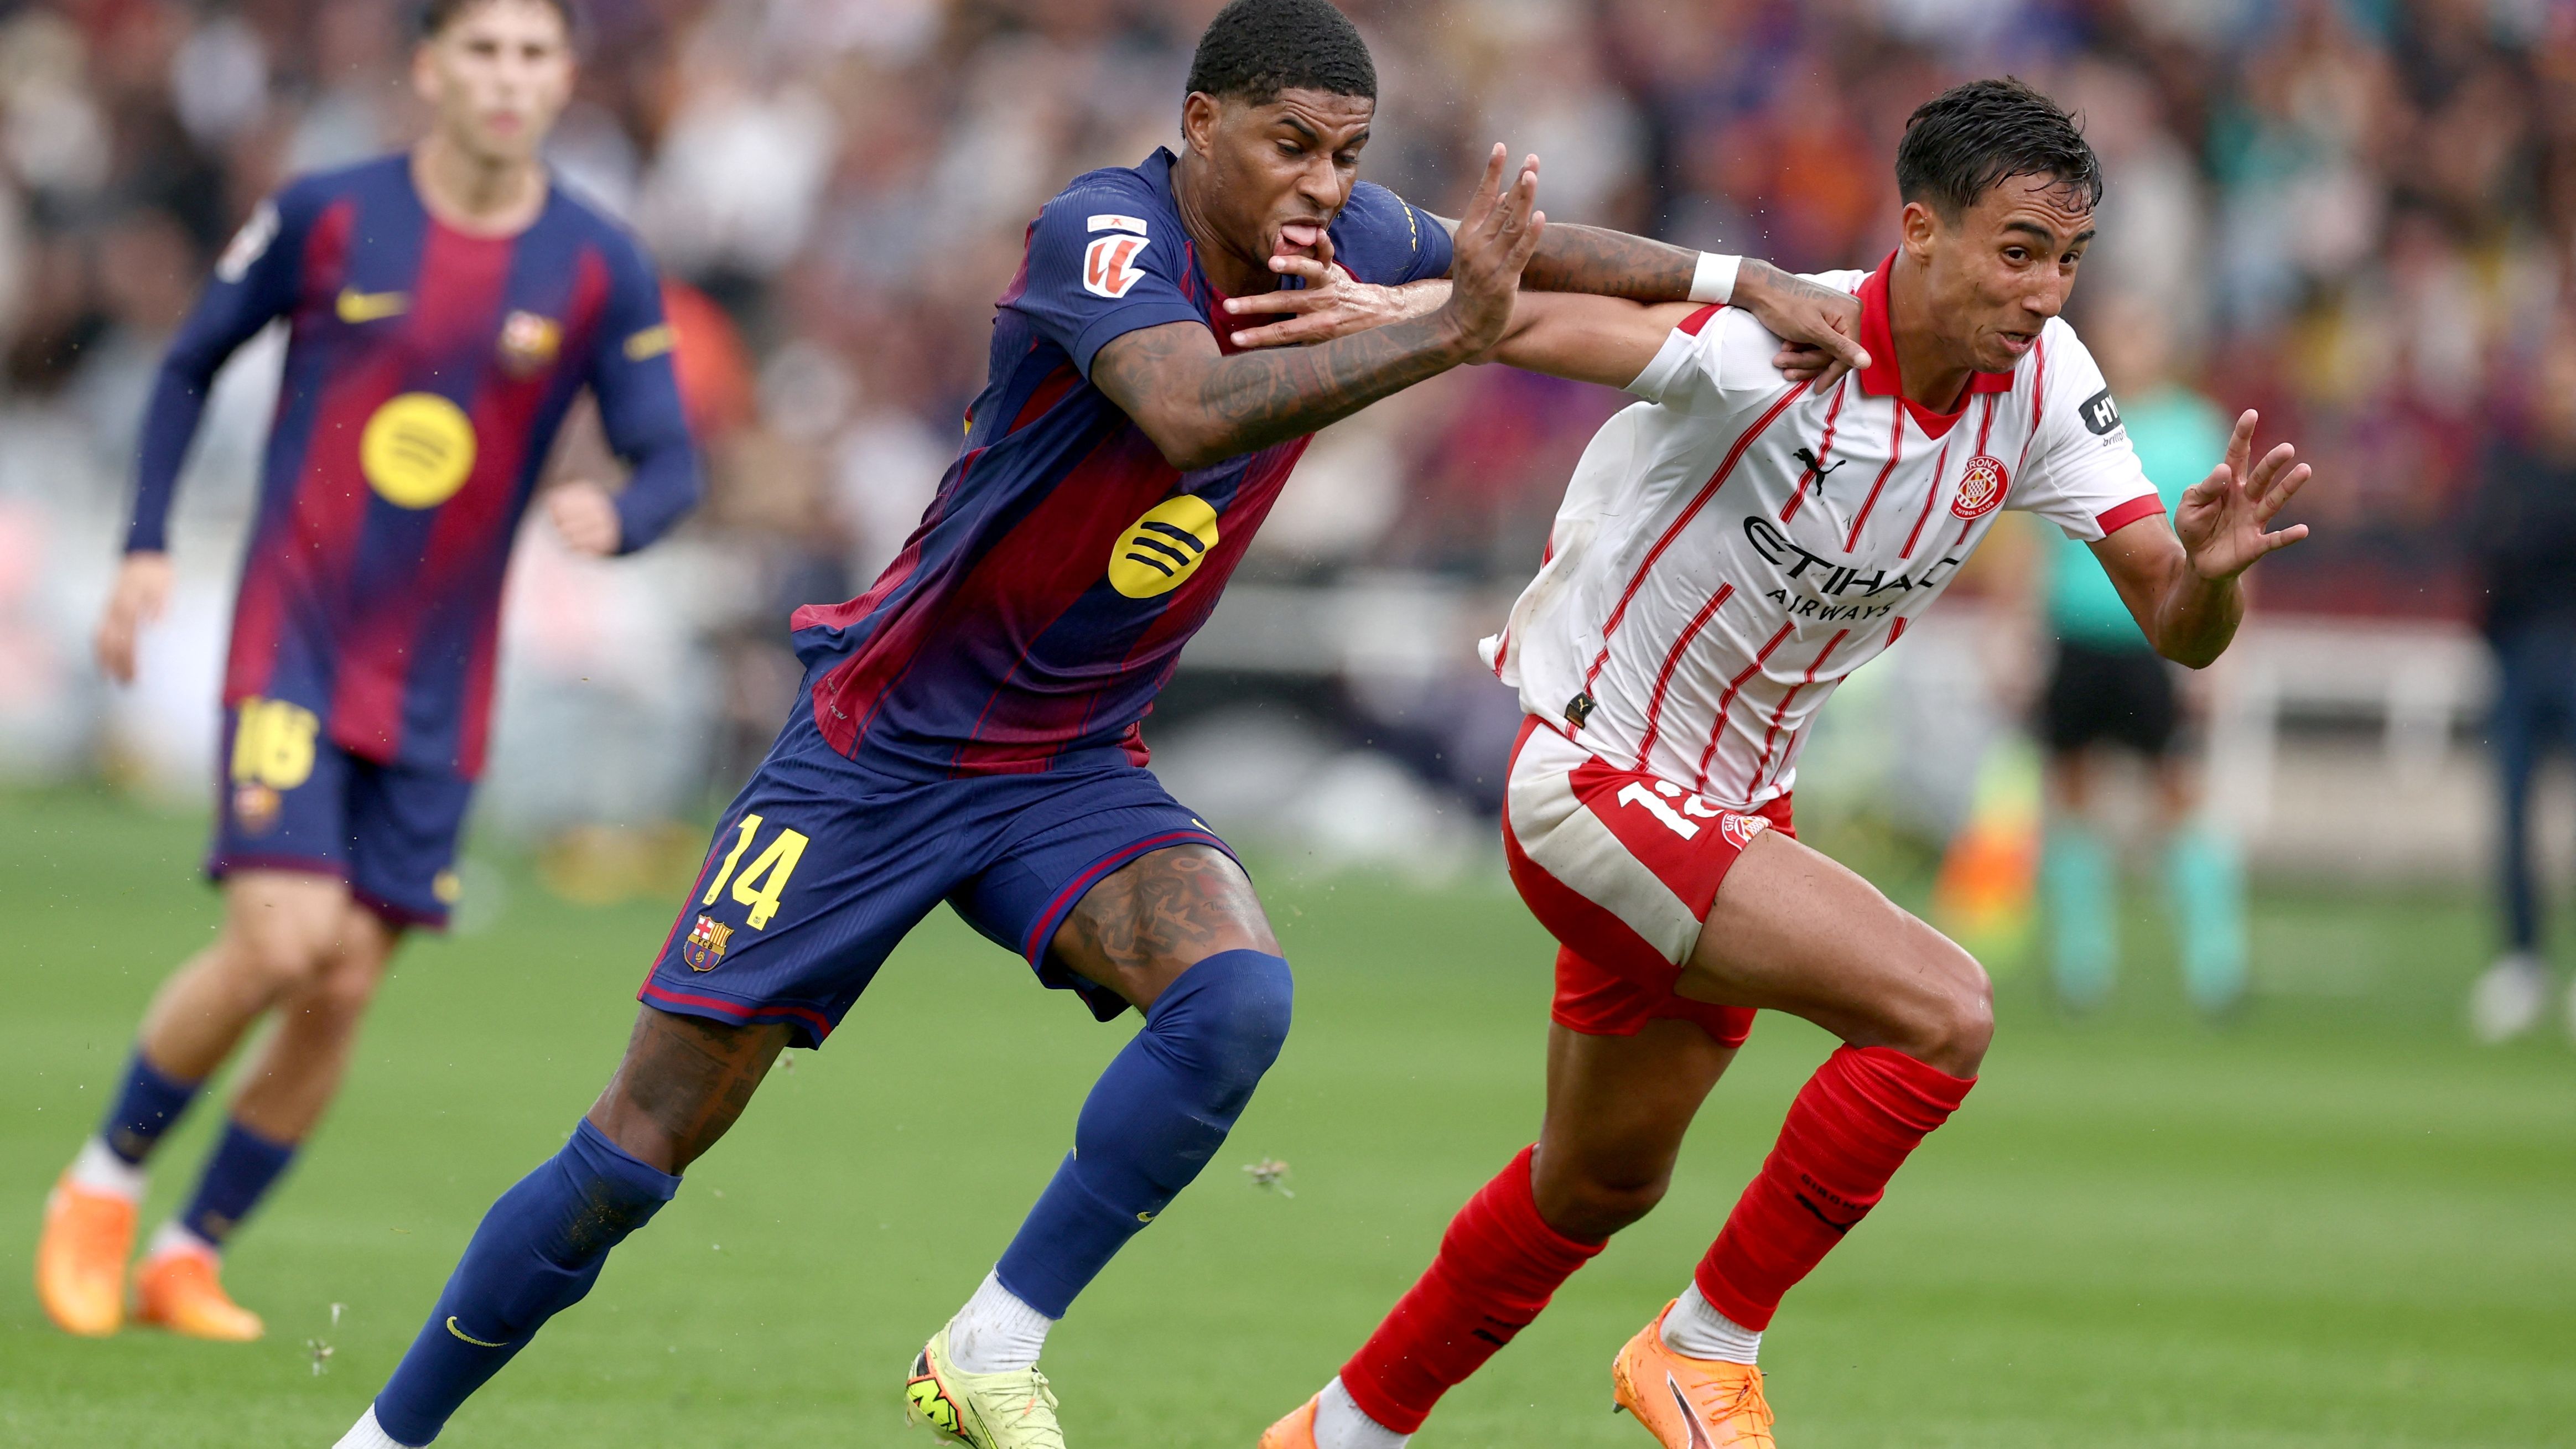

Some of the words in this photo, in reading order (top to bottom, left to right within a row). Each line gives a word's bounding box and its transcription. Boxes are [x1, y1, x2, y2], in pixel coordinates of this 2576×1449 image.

[2093, 394, 2119, 428] HY
[1965, 458, 1999, 473] IRONA
[1955, 507, 1977, 516] FUTBOL
[1978, 501, 1995, 513] CLUB
[1766, 589, 1895, 621] AIRWAYS
[702, 813, 809, 931] 14
[698, 938, 713, 950] FCB
